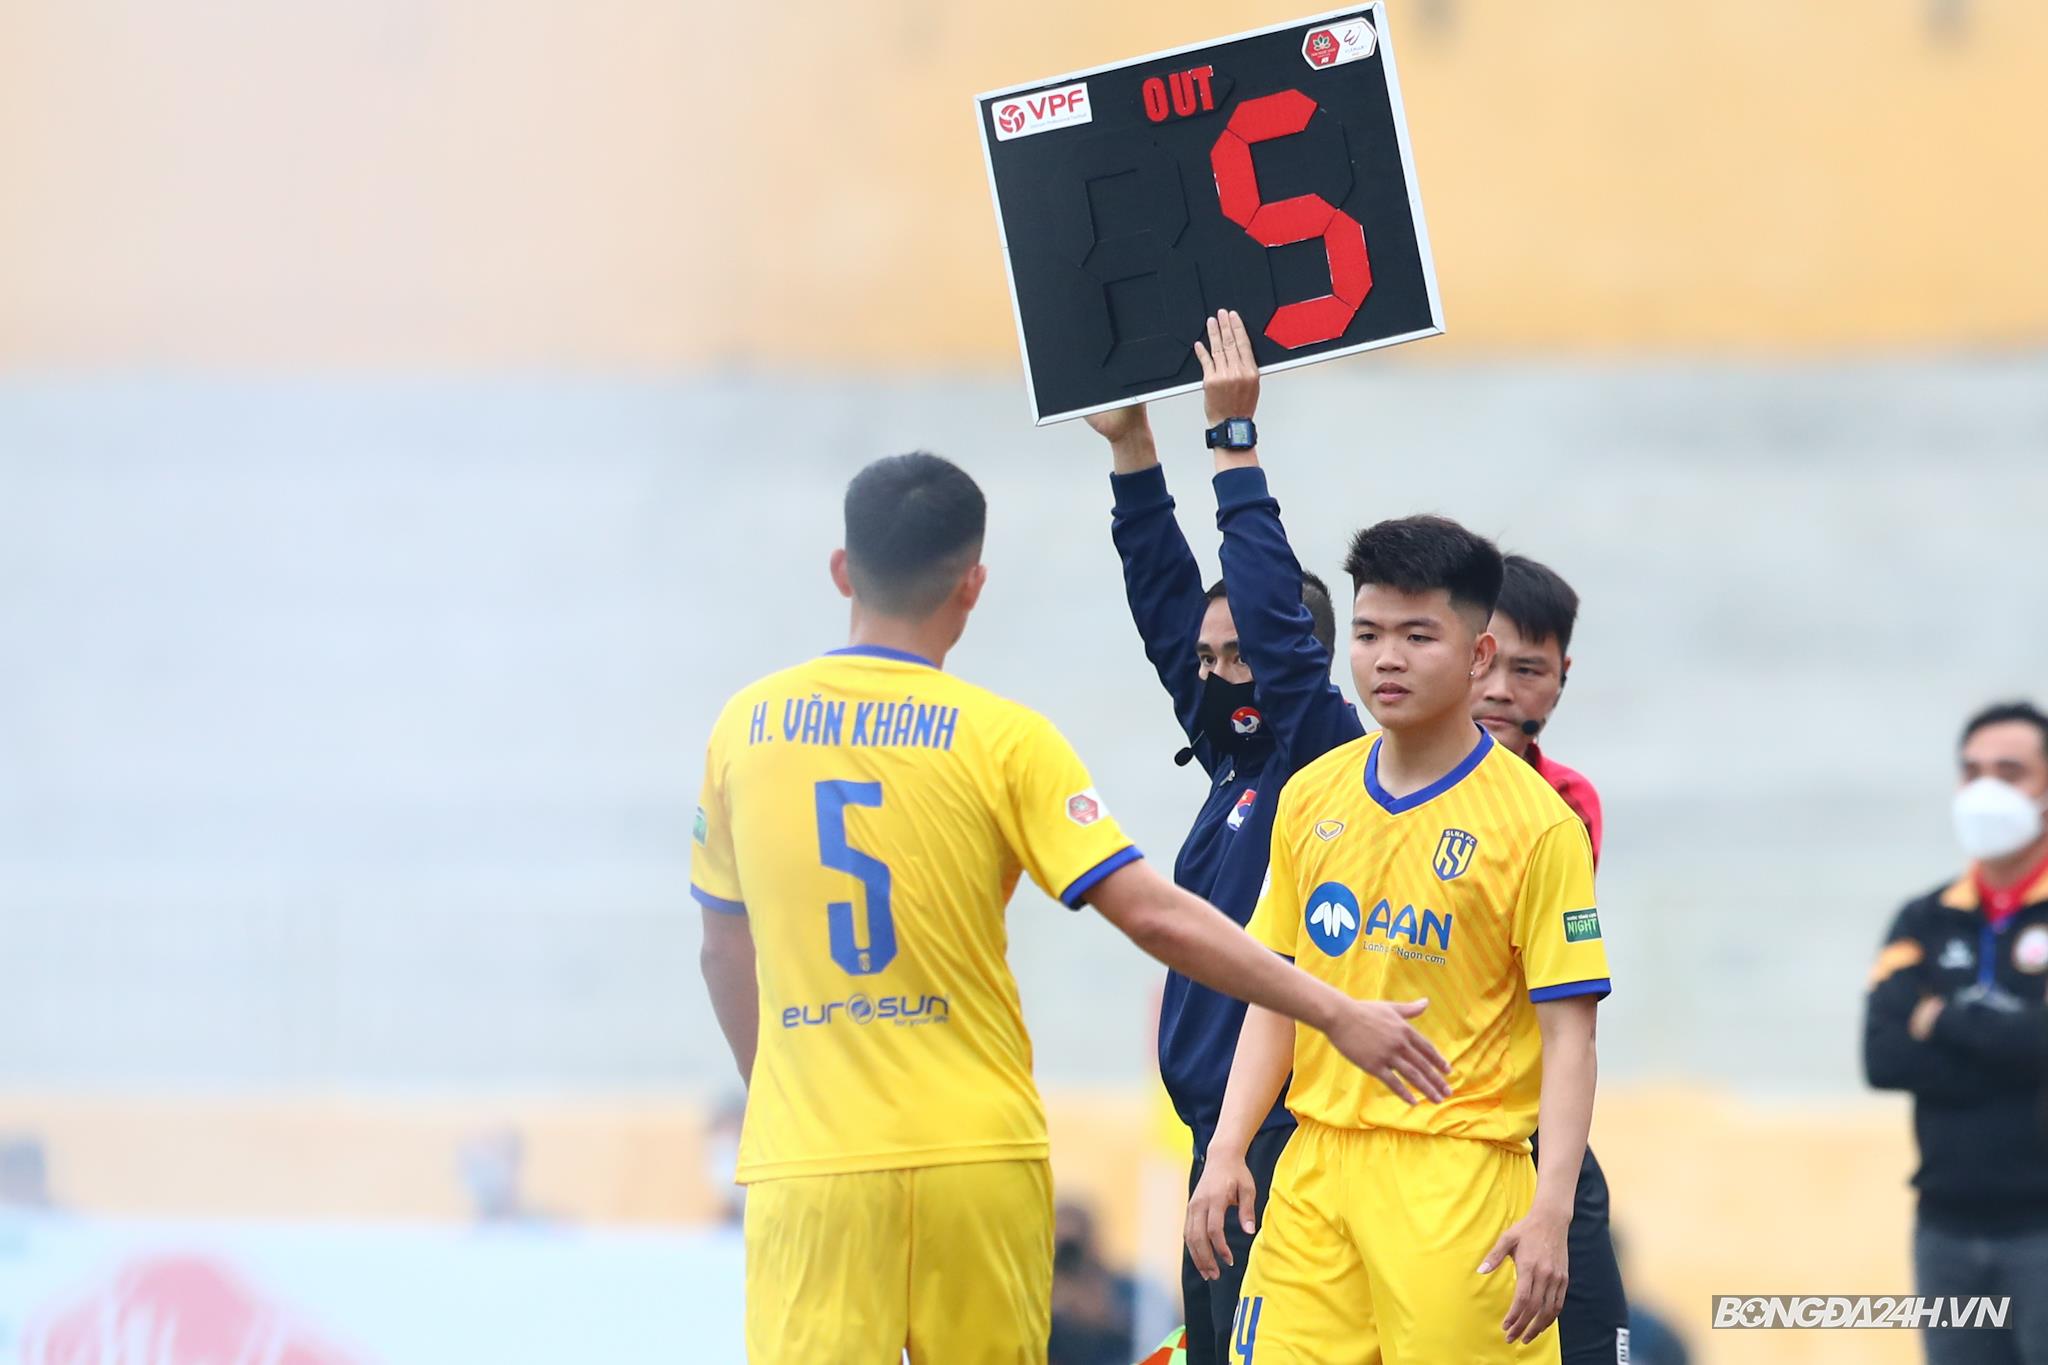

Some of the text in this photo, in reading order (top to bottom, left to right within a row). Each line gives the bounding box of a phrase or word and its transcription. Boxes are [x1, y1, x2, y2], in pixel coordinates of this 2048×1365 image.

[1026, 89, 1084, 120] VPF
[1142, 65, 1214, 122] OUT
[1210, 88, 1373, 351] 5
[750, 693, 959, 752] H. VĂN KHÁNH
[814, 779, 898, 976] 5
[1365, 898, 1453, 951] AAN
[1567, 918, 1598, 937] NIGHT
